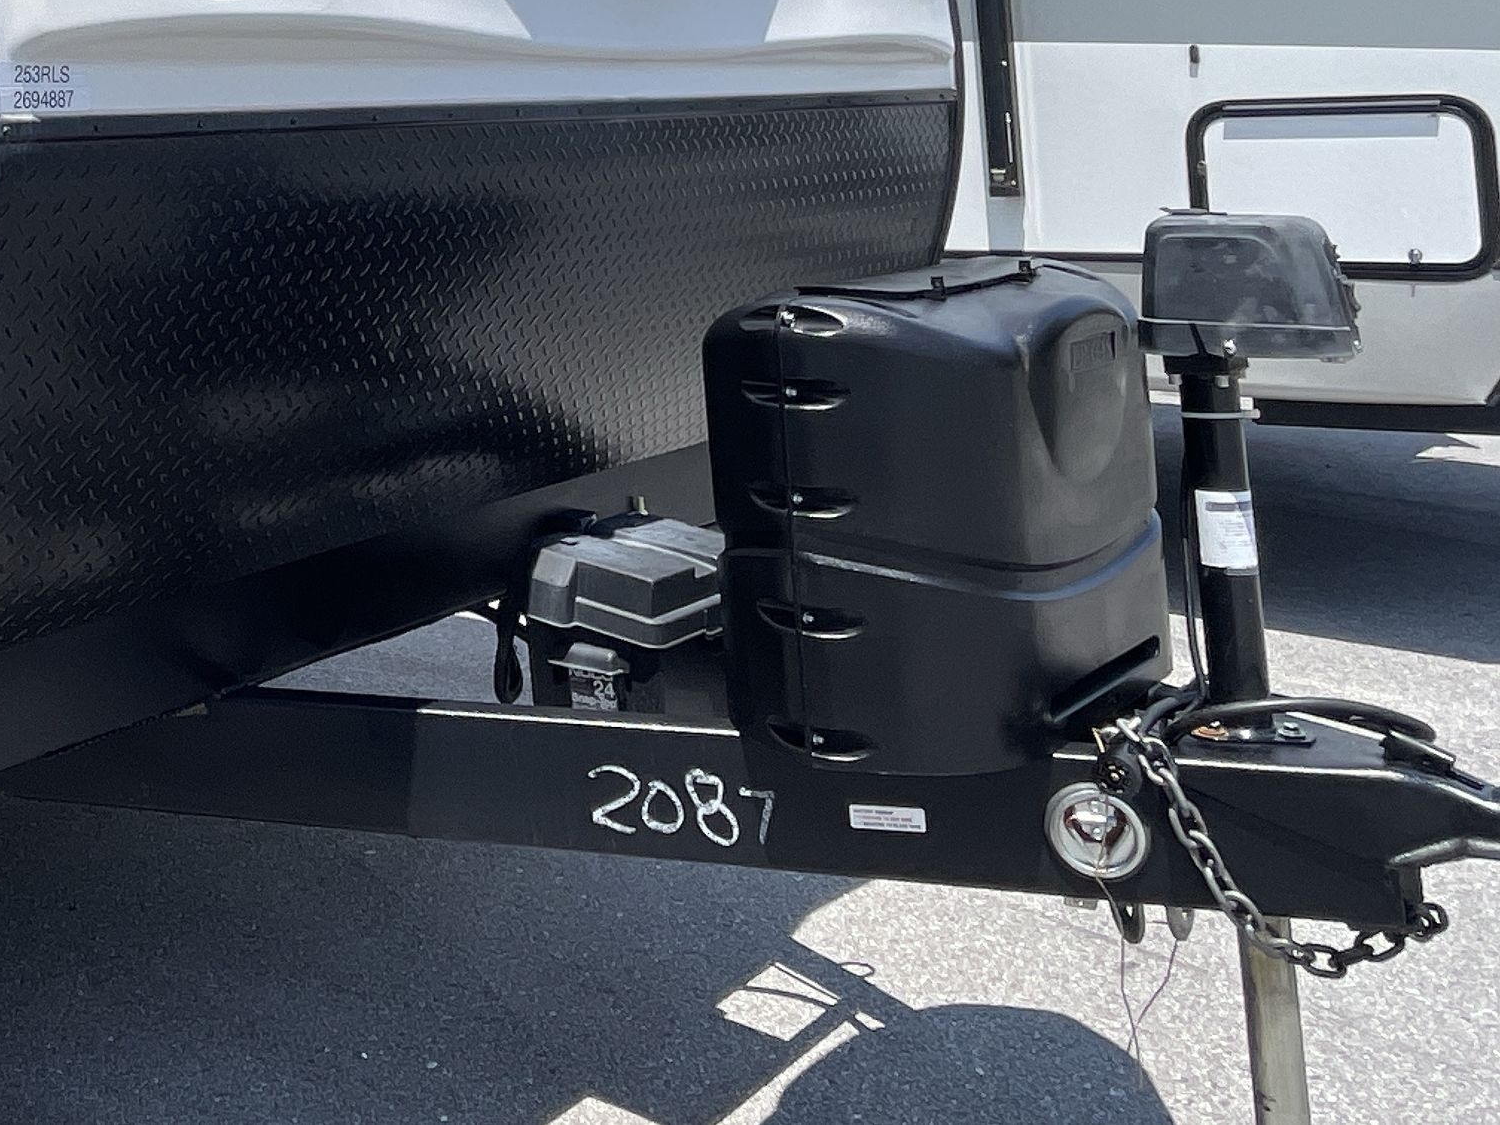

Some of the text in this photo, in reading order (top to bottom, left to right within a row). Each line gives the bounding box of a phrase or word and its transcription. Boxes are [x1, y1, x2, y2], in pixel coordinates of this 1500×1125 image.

[14, 65, 70, 83] 253RLS
[13, 89, 74, 109] 2694887
[593, 680, 616, 699] 24
[588, 764, 775, 846] 2087
